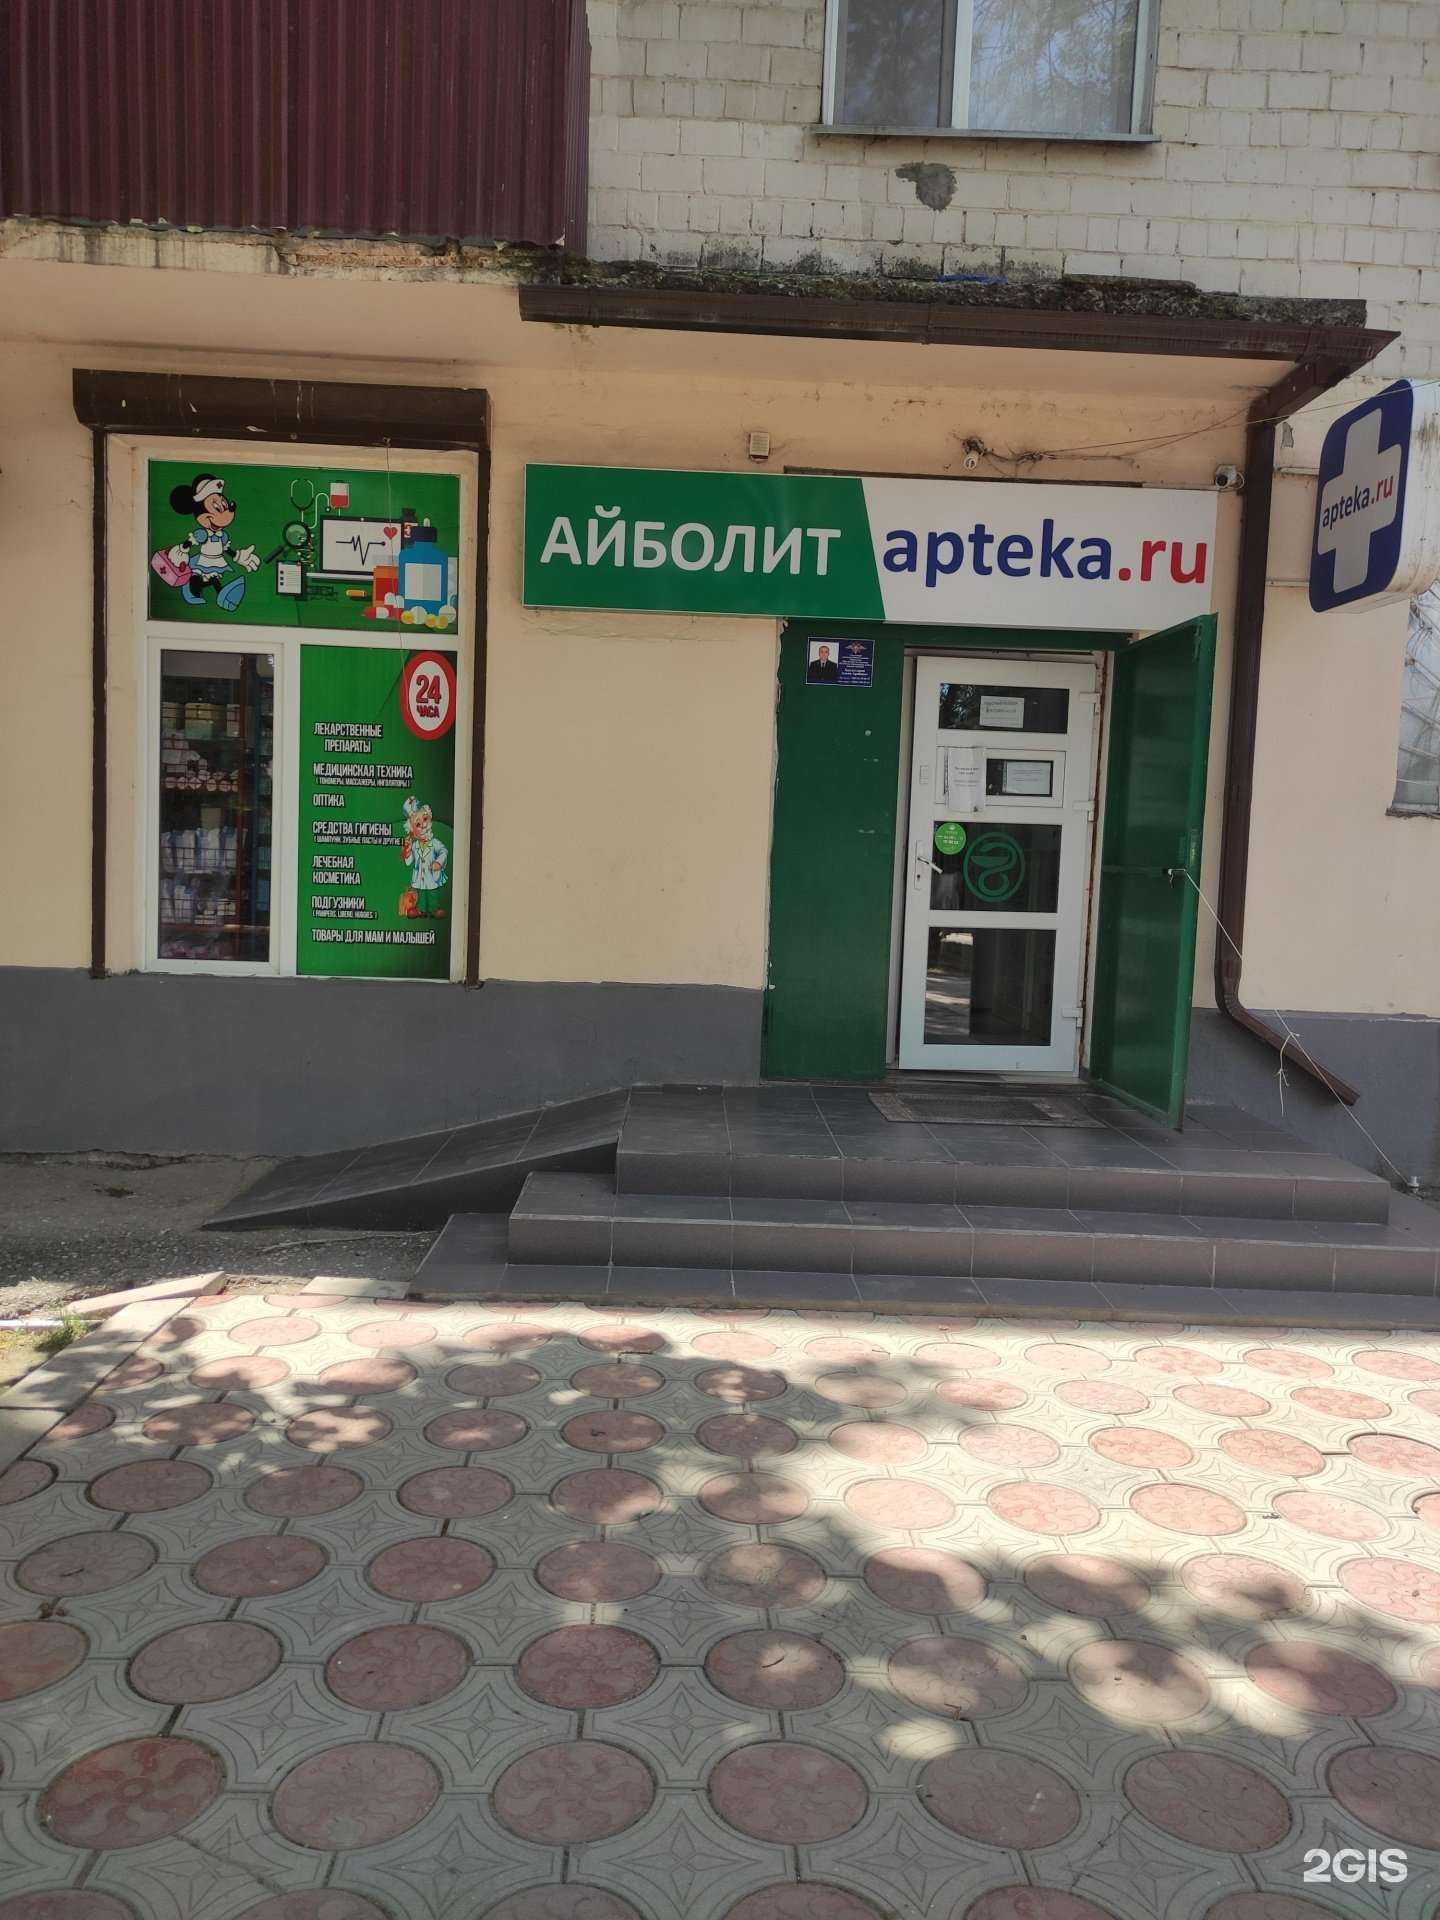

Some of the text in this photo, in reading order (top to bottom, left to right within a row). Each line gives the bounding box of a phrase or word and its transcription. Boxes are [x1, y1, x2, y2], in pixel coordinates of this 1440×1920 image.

[1322, 474, 1393, 531] apteka.ru
[538, 504, 842, 576] АЙБОЛИТ
[882, 518, 1209, 588] apteka.ru
[416, 674, 442, 704] 24
[416, 705, 440, 718] ЧАСА
[313, 722, 382, 737] ЛЕКАРСТВЕННЫЕ
[325, 739, 371, 752] ПРЕПАРАТЫ
[313, 763, 413, 778] МЕДИЦИНСКАЯ ТЕХНИКА
[313, 794, 344, 807] ОПТИКА
[313, 821, 391, 835] СРЕДСТВА ГИГИЕНЫ
[312, 855, 354, 868] ЛЕЧЕБНАЯ
[312, 871, 361, 884] КОСМЕТИКА
[311, 896, 365, 909] ПОДГУЗНИКИ
[312, 929, 435, 944] ТОВАРЫ ДЛЯ МАМ И МАЛЫШЕЙ
